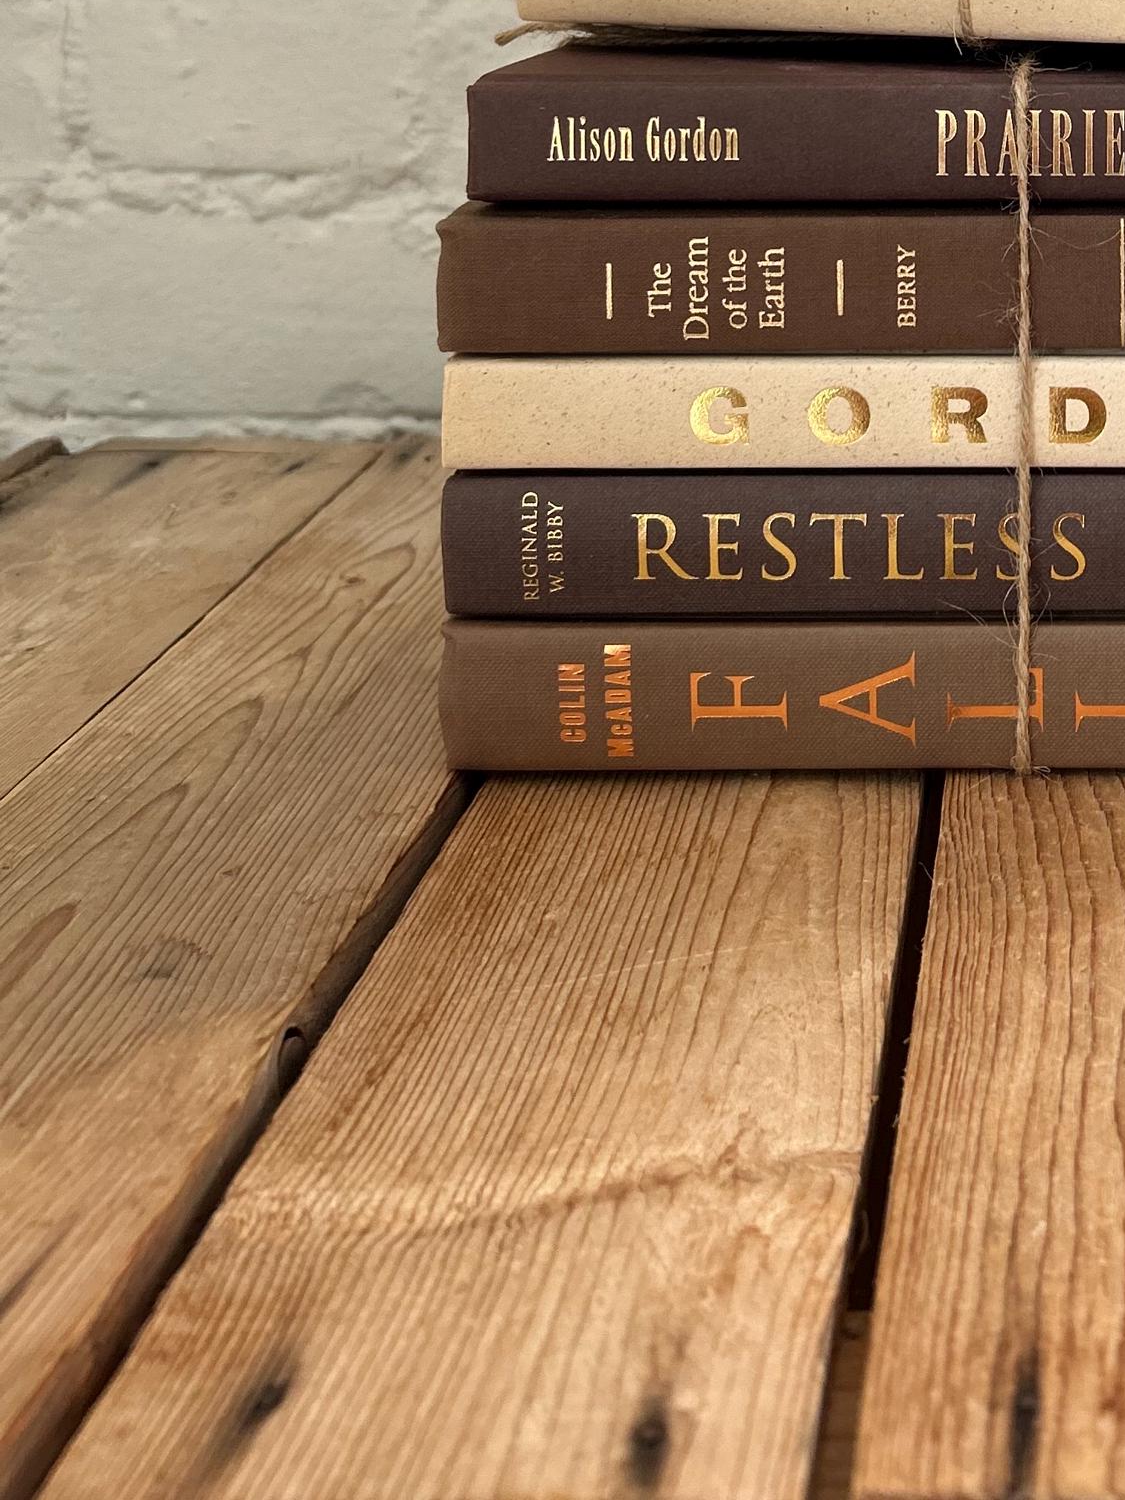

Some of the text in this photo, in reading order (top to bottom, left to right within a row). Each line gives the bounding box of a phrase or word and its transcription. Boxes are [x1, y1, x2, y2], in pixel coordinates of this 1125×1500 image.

[546, 116, 741, 162] Alison Gordon
[934, 109, 1125, 177] PRAIRIE
[648, 262, 672, 318] The
[683, 236, 710, 342] Dream
[722, 248, 748, 329] of the
[758, 246, 786, 330] Earth
[896, 245, 917, 327] BERRY
[522, 491, 540, 601] REGINALD
[547, 500, 566, 593] W. BIBBY
[631, 512, 1087, 582] RESTLESS
[558, 663, 586, 743] COLIN
